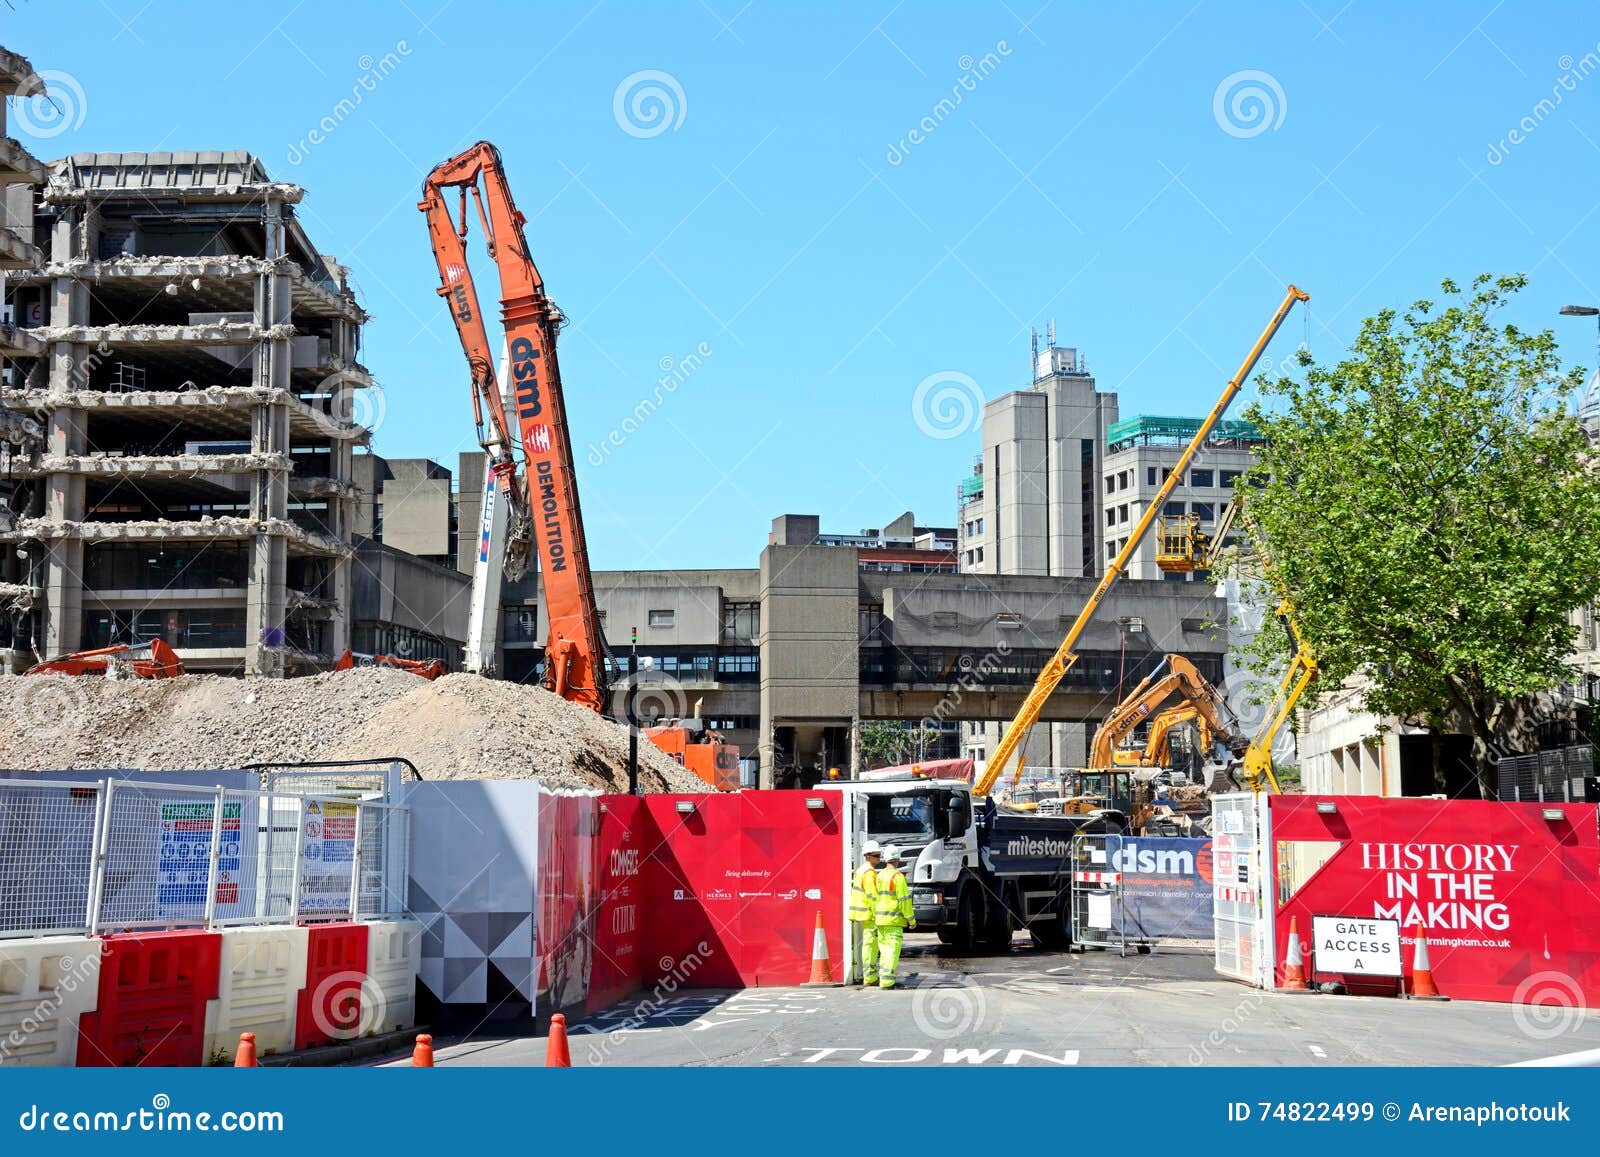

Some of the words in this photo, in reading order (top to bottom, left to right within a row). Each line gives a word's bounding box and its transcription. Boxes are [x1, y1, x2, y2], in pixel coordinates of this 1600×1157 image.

[511, 337, 542, 419] dsm
[536, 461, 567, 573] DEMOLITION
[1120, 711, 1139, 729] dsm
[1112, 843, 1193, 874] dsm
[1360, 843, 1519, 871] HISTORY
[1387, 872, 1419, 899] IN
[1427, 873, 1495, 901] THE
[1335, 922, 1377, 935] GATE
[1373, 901, 1510, 931] MAKING
[1324, 939, 1391, 954] ACCESS
[1354, 958, 1364, 969] A
[800, 1047, 1080, 1065] TOWN
